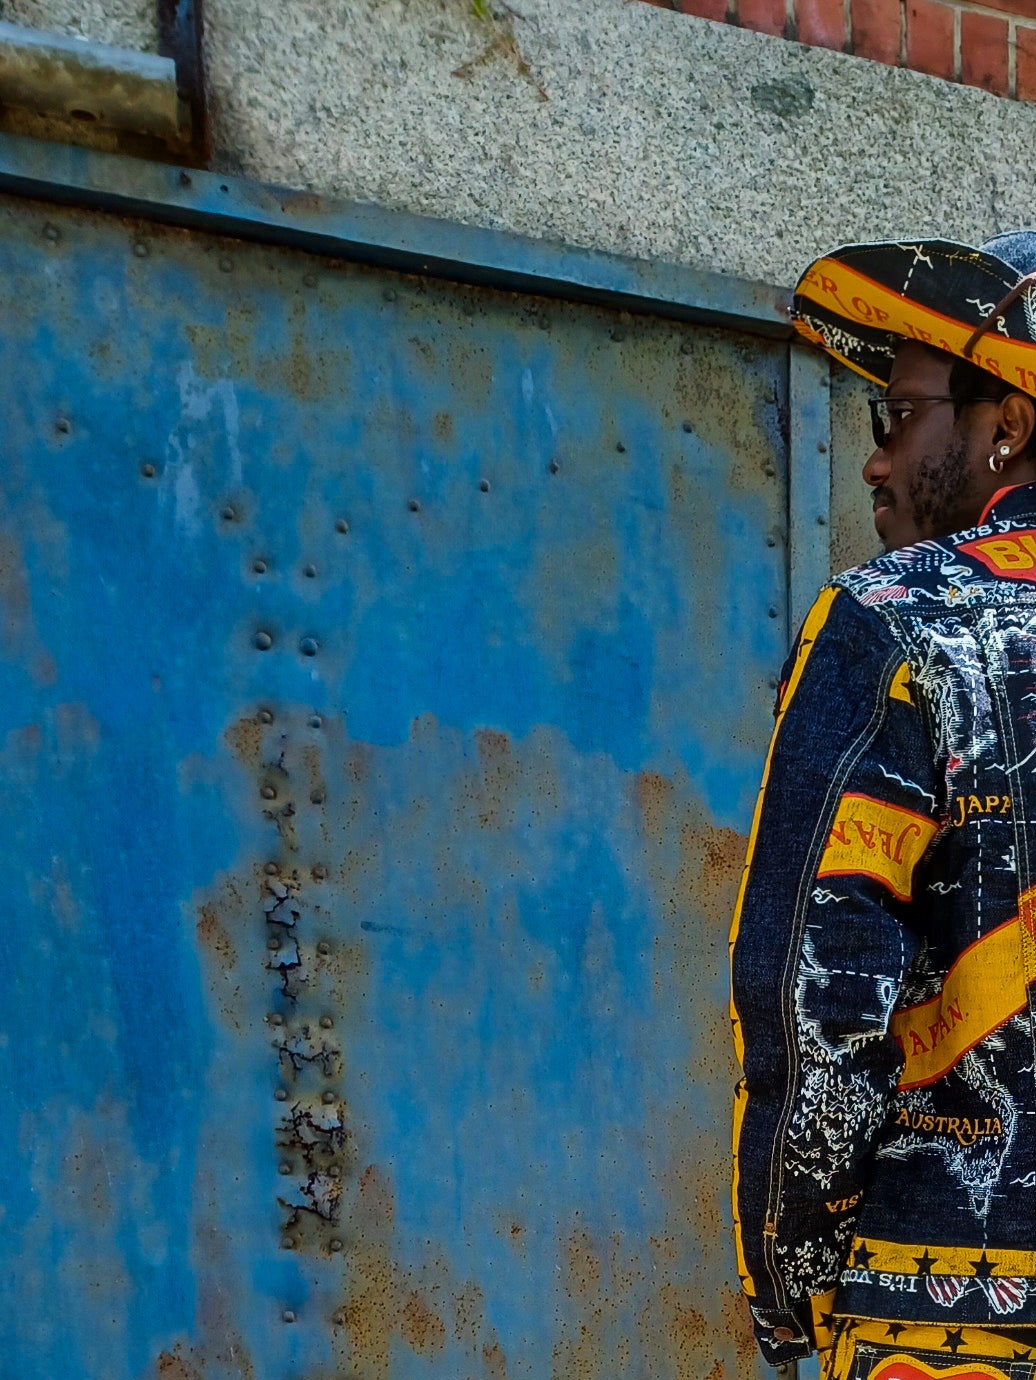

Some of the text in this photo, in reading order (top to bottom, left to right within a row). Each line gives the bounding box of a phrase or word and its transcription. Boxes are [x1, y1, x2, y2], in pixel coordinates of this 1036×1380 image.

[852, 296, 890, 323] OF
[948, 524, 993, 546] It's
[895, 1107, 1003, 1146] AUSTRALIA
[825, 1189, 864, 1213] SIA
[879, 1272, 919, 1293] It's
